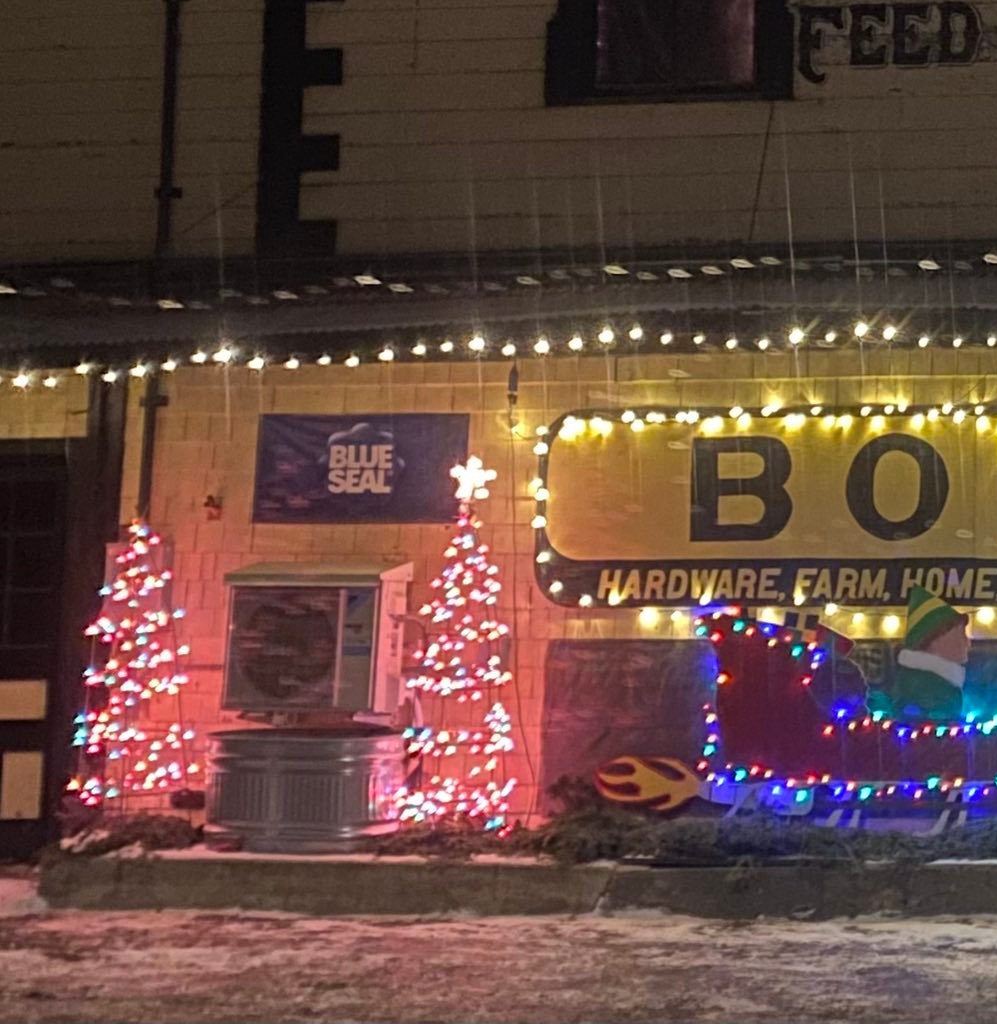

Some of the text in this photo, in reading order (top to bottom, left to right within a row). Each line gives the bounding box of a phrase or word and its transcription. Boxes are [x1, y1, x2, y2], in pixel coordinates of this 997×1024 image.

[798, 1, 982, 84] FEED
[328, 444, 394, 470] BLUE
[327, 469, 393, 494] SEAL
[597, 568, 785, 603] HARDWARE,
[792, 567, 892, 603] FARM,
